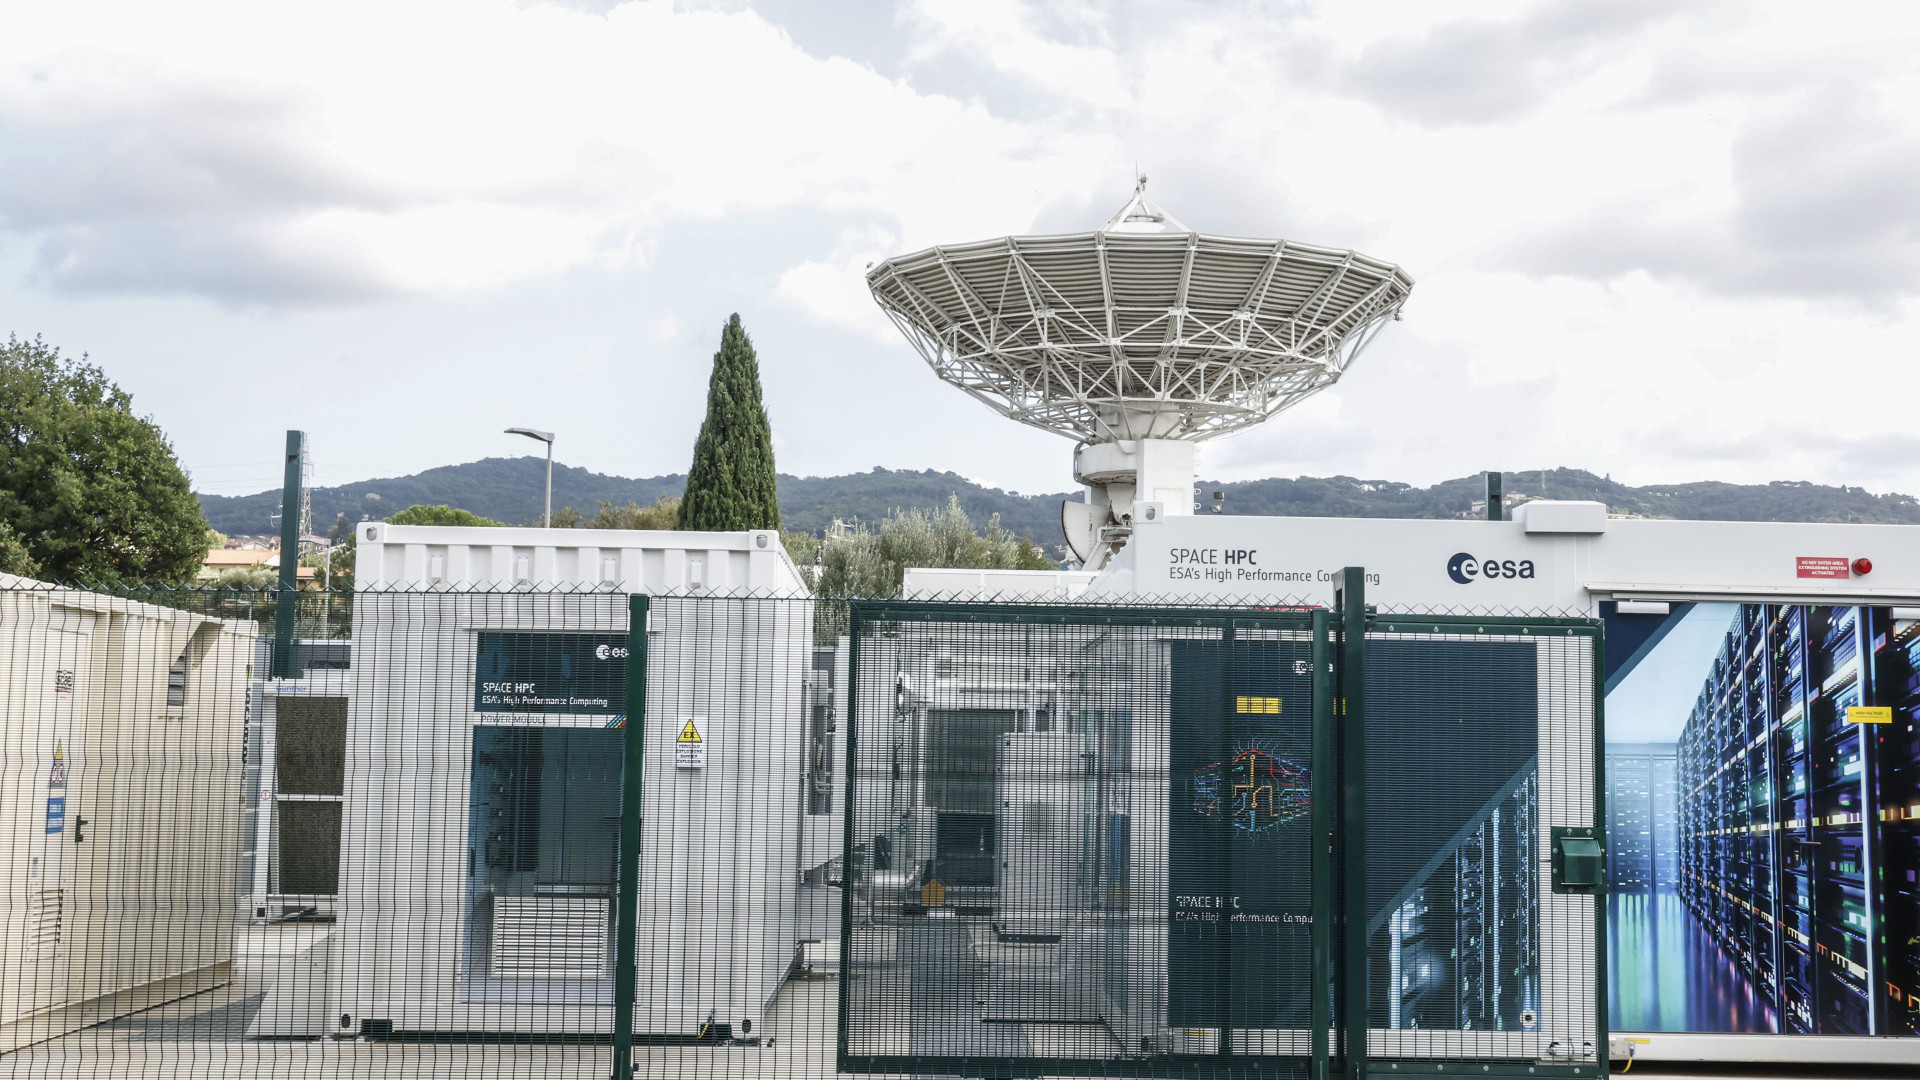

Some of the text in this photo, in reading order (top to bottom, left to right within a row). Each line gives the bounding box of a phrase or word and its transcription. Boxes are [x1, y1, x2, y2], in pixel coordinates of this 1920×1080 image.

[1170, 548, 1257, 565] SPACE HPC
[1169, 566, 1200, 579] ESA's
[1205, 567, 1232, 583] High
[1237, 568, 1312, 582] Performance
[482, 682, 536, 694] SPACE HPC
[482, 695, 608, 708] ESA's High Performance Computing
[482, 715, 547, 724] POWER MODULE
[1215, 896, 1240, 908] HC
[1230, 912, 1280, 923] erformance
